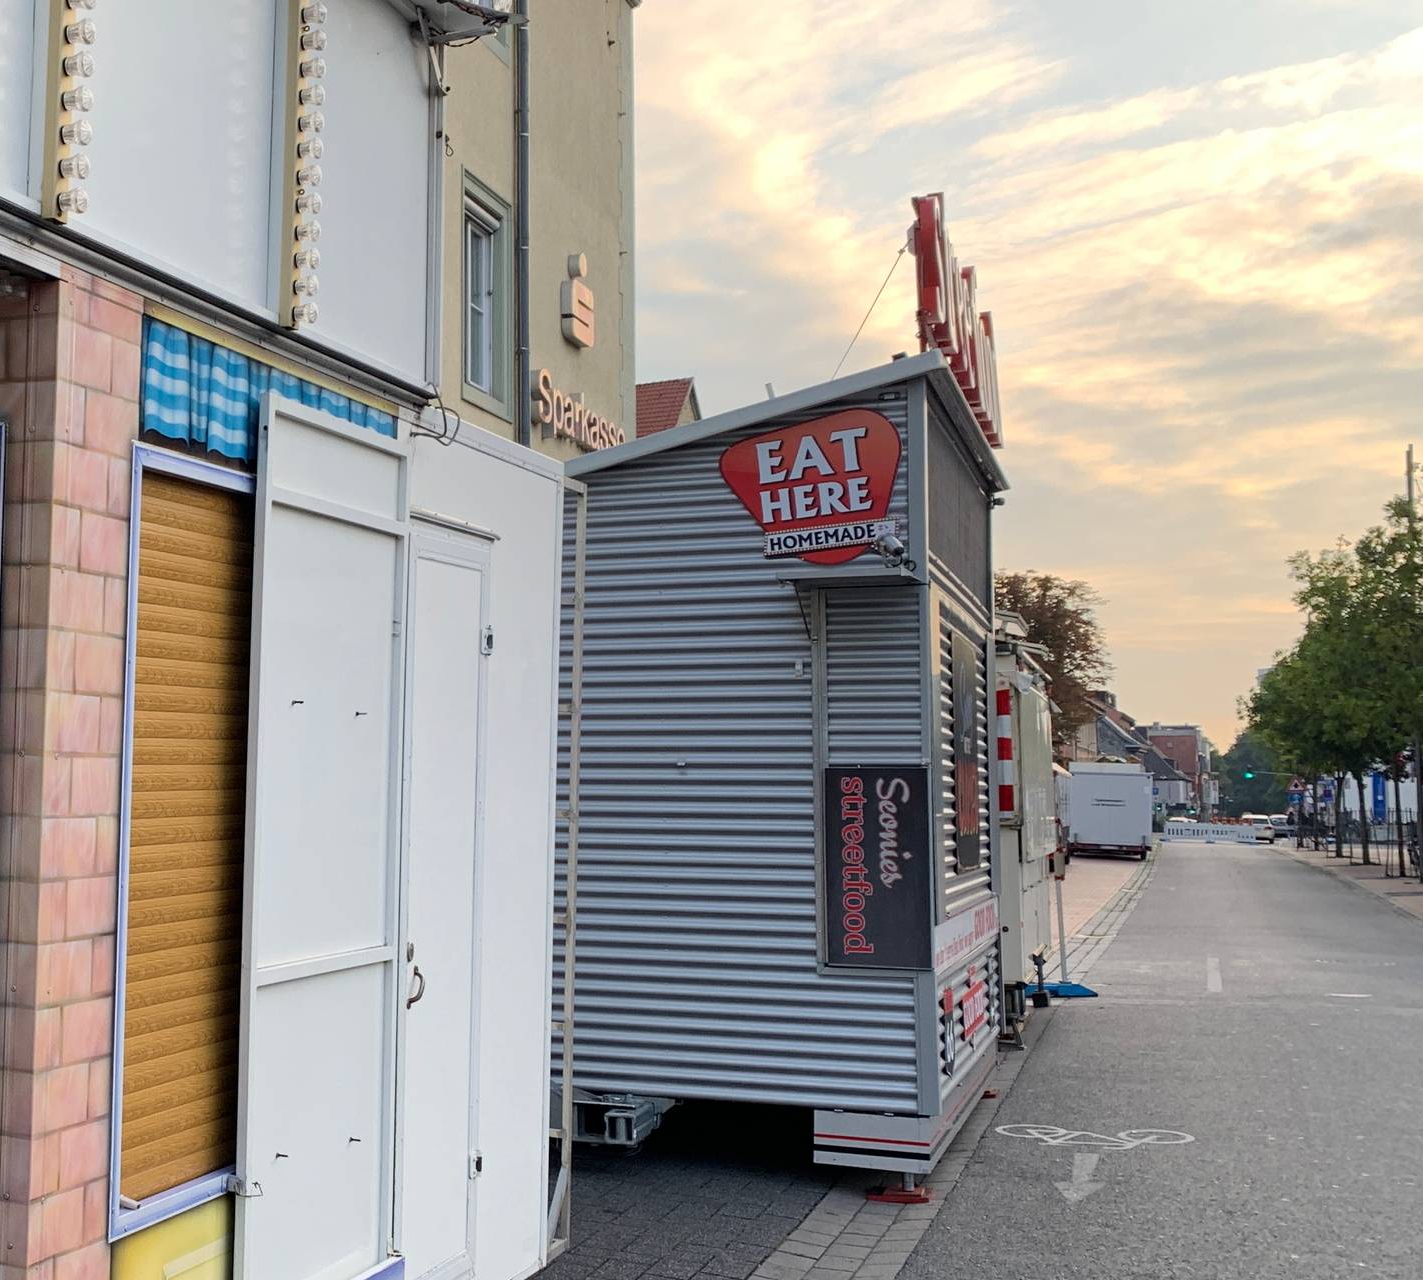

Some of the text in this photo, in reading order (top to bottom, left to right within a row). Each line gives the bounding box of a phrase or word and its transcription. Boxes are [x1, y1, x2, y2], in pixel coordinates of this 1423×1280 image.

[755, 427, 867, 485] EAT
[759, 476, 873, 524] HERE
[769, 523, 876, 551] HOMEMADE
[876, 777, 913, 889] Seonies
[840, 776, 875, 956] streetfood
